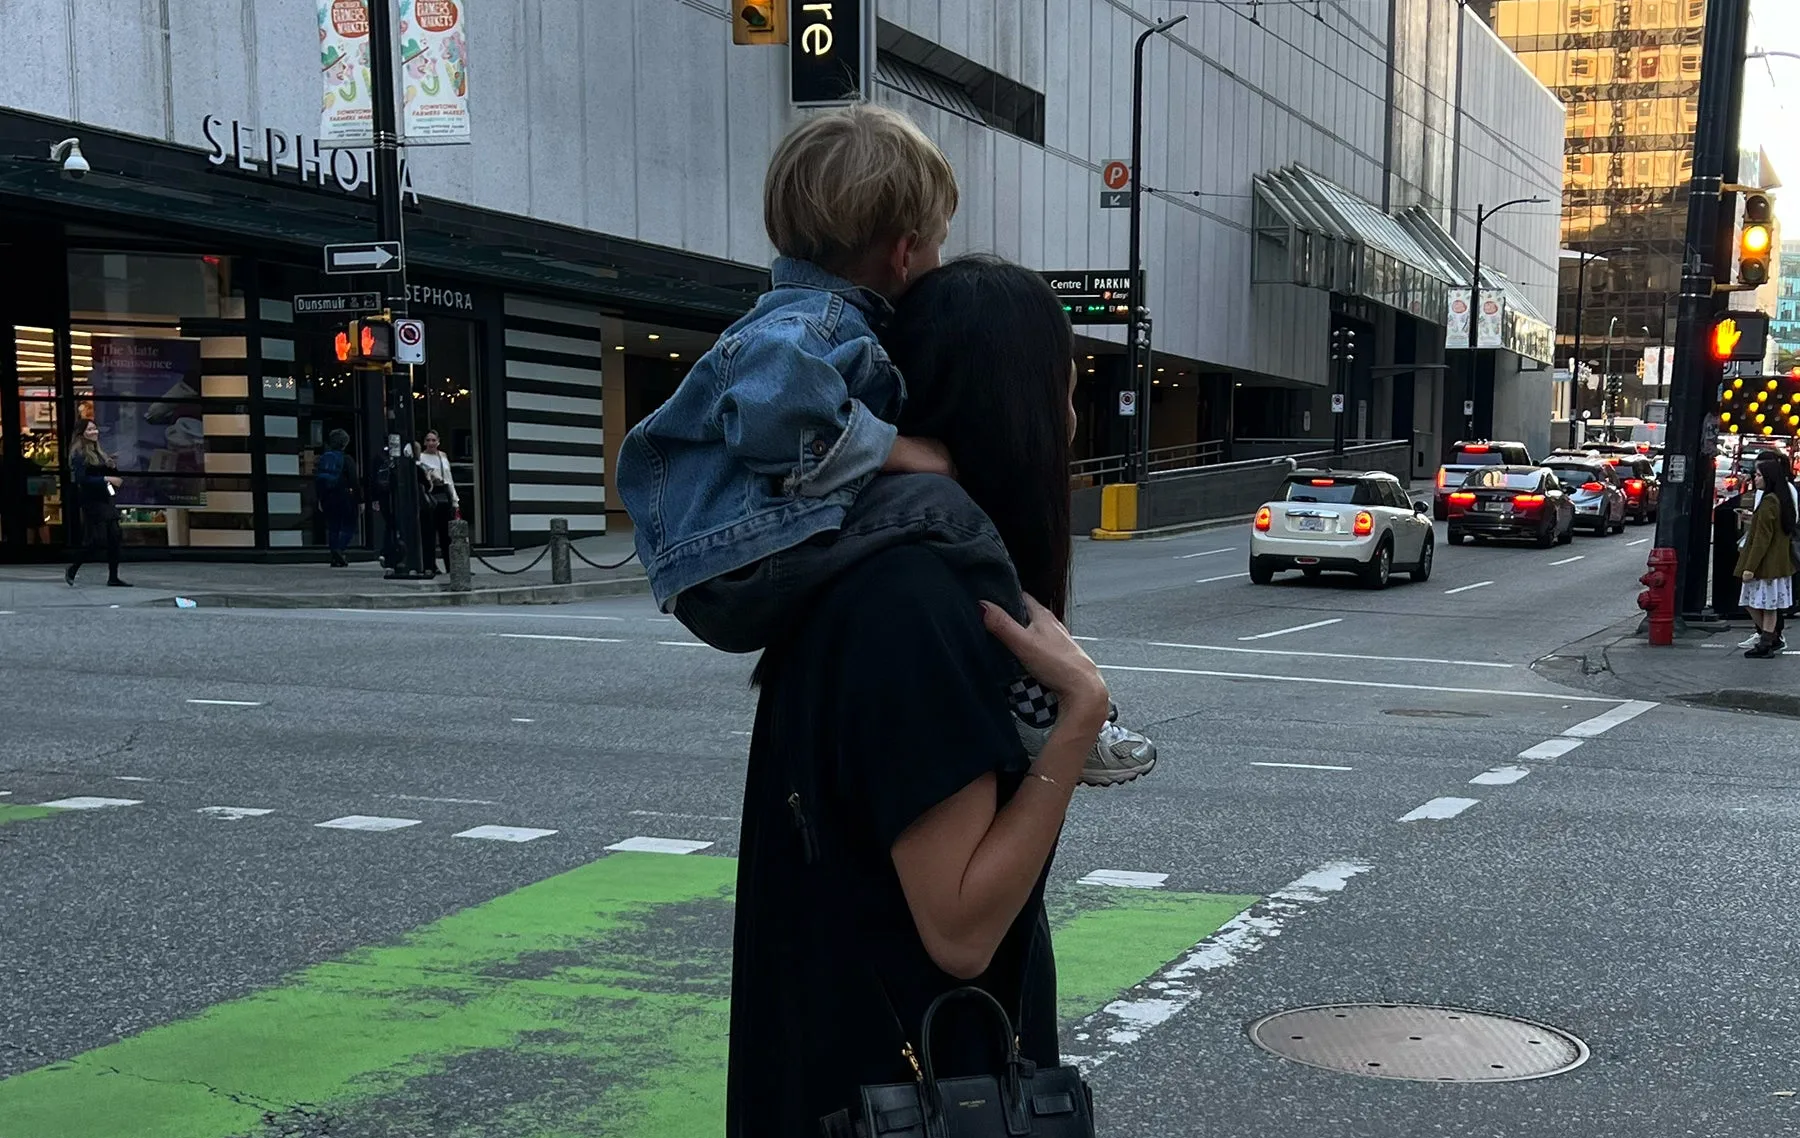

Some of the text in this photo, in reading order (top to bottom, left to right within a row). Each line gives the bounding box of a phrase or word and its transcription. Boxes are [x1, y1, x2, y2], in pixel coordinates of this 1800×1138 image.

[1110, 167, 1124, 185] P
[1050, 278, 1130, 289] Centre PARKIN
[298, 296, 346, 310] Dunsmuir
[405, 284, 473, 310] SEPHORA
[100, 344, 123, 355] The
